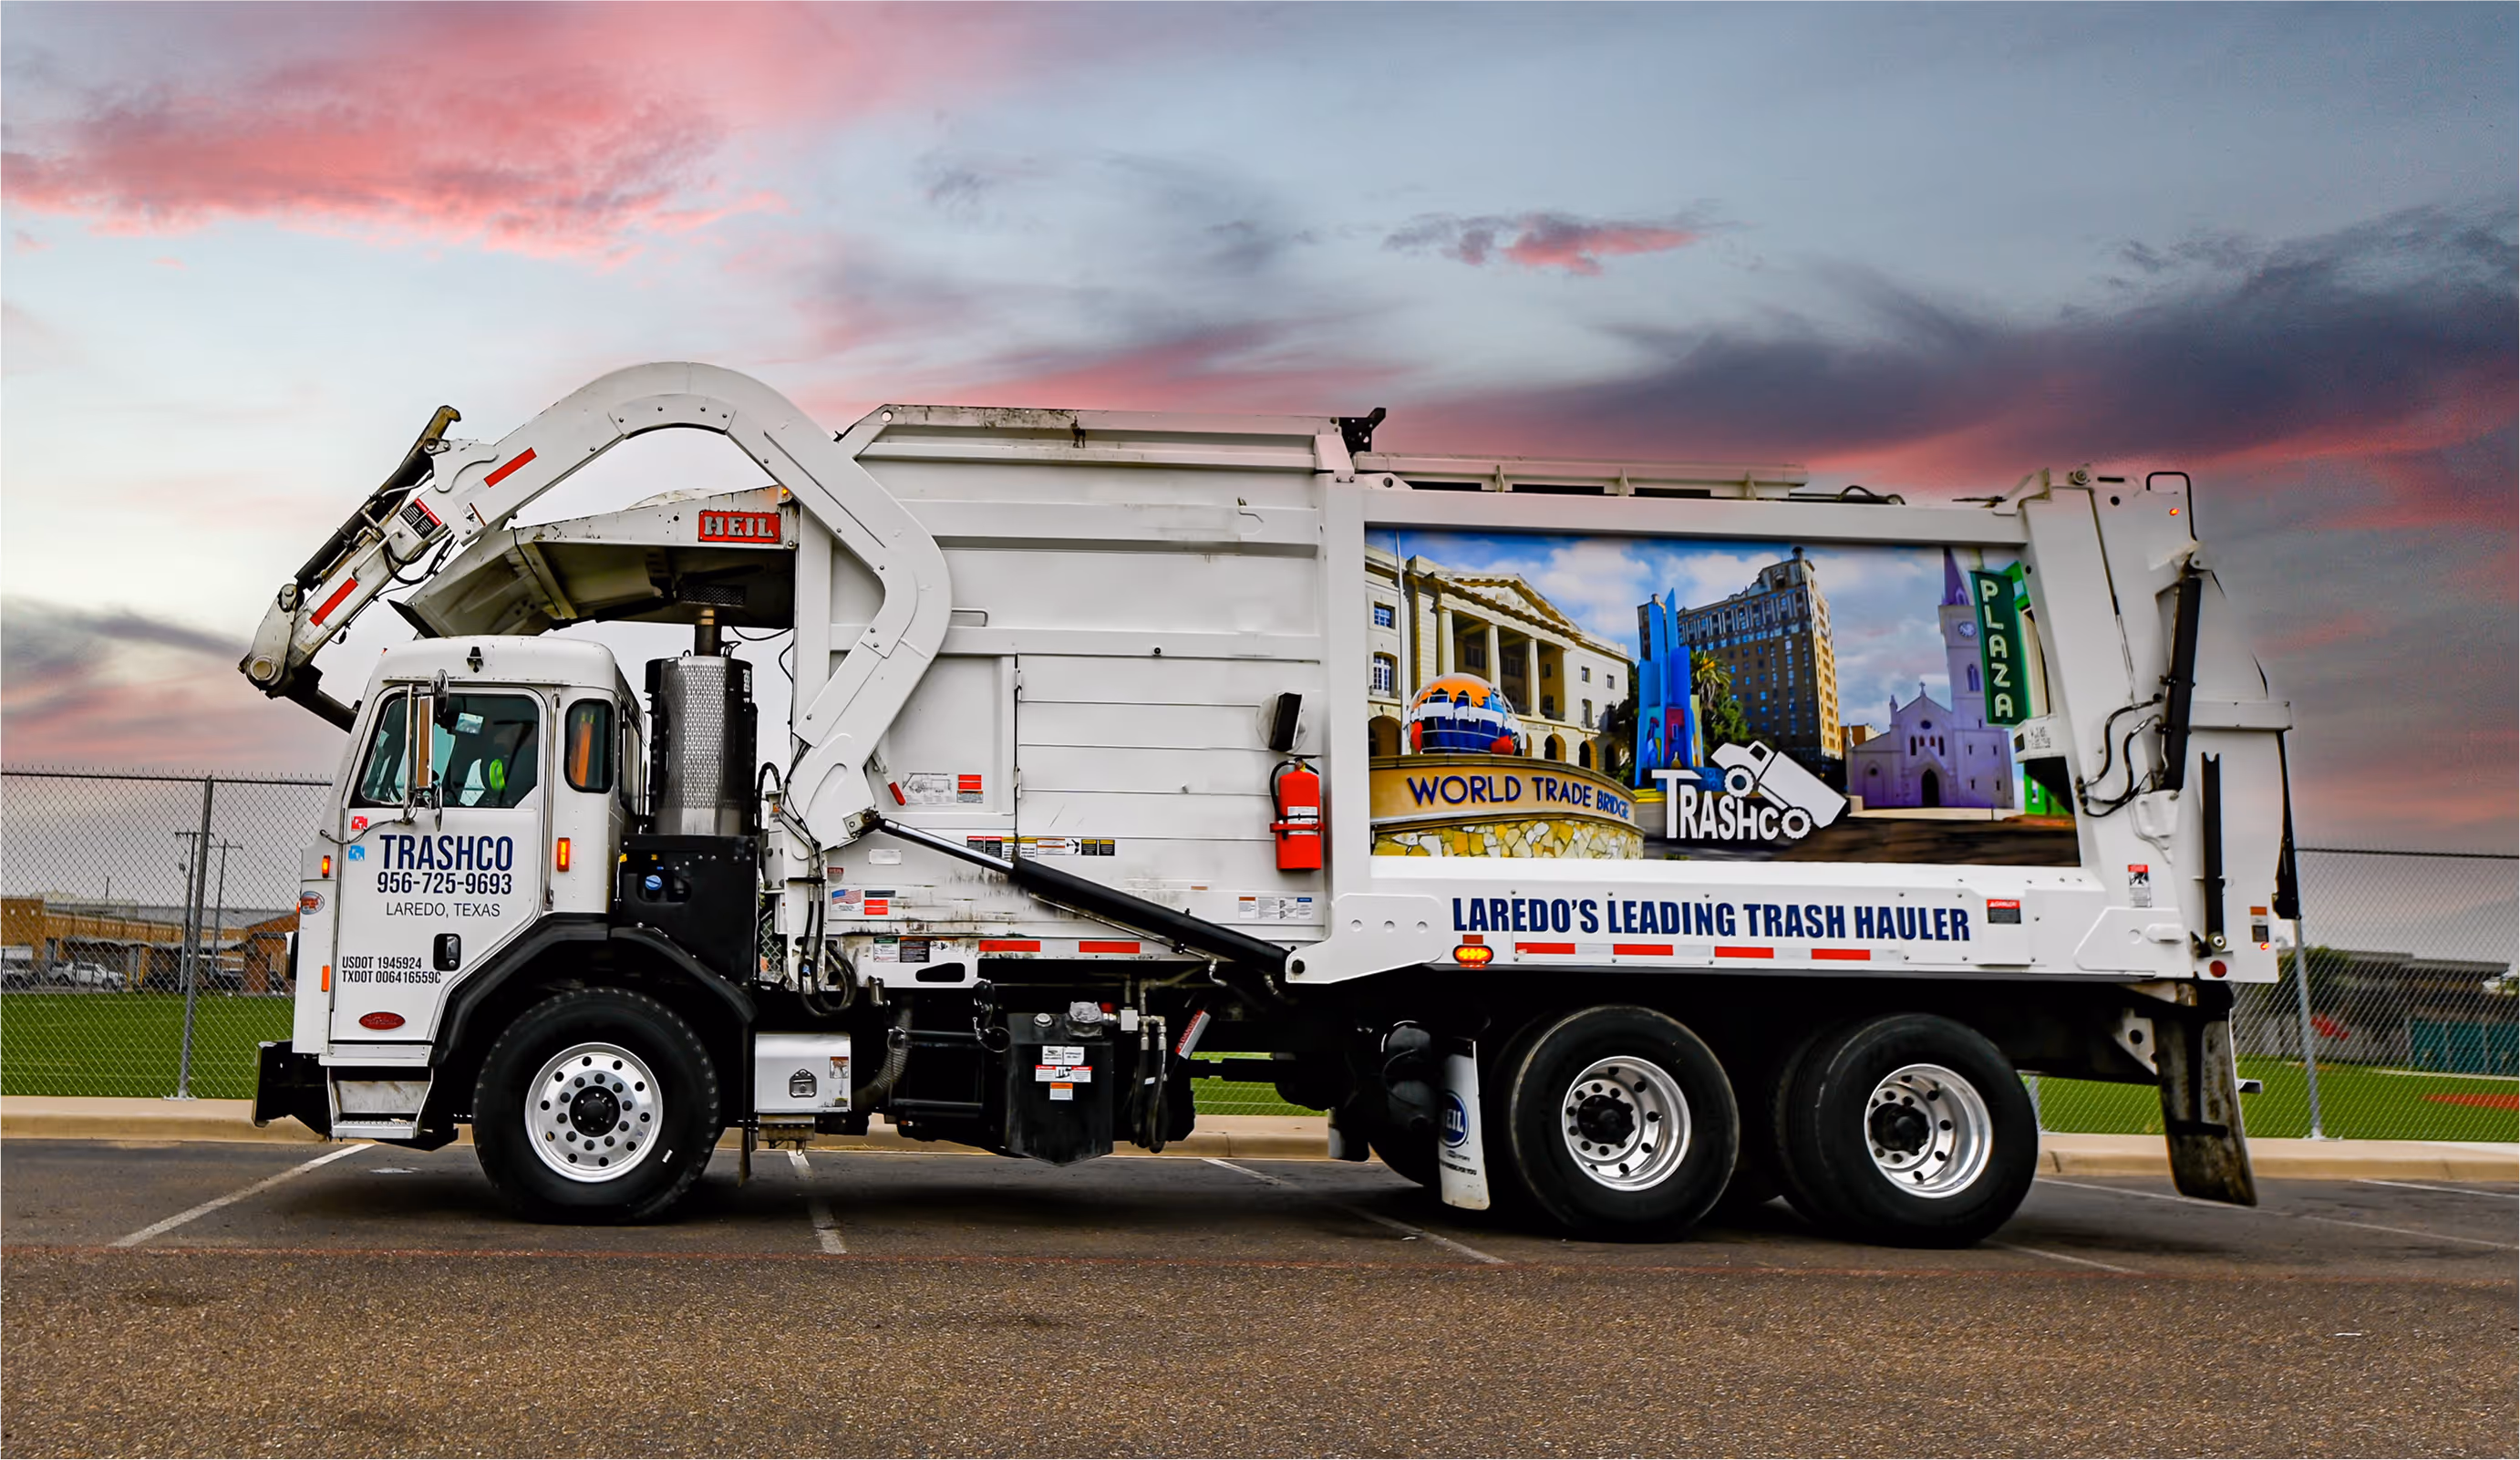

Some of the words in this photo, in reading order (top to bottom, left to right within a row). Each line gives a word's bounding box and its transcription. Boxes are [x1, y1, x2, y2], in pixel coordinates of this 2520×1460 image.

[704, 516, 774, 537] HEIL
[1979, 578, 2014, 719] PLAZA
[1407, 775, 1523, 805] WORLD
[1532, 777, 1593, 808] TRADE
[1596, 789, 1630, 820] BRIDGE
[379, 834, 514, 872] TRASHCO
[377, 872, 512, 895] 956-725-9693
[386, 902, 449, 918] LAREDO,
[453, 903, 501, 917] TEXAS
[1451, 897, 1599, 934] LAREDO'S
[1606, 900, 1737, 937] LEADING
[1742, 903, 1846, 939] TRASH
[1854, 906, 1971, 942] HAULER
[342, 956, 374, 969] USDOT
[377, 957, 422, 969] 1945924
[342, 970, 374, 983] TXDOT
[376, 970, 441, 984] 006416559C
[1442, 1107, 1464, 1134] EIL
